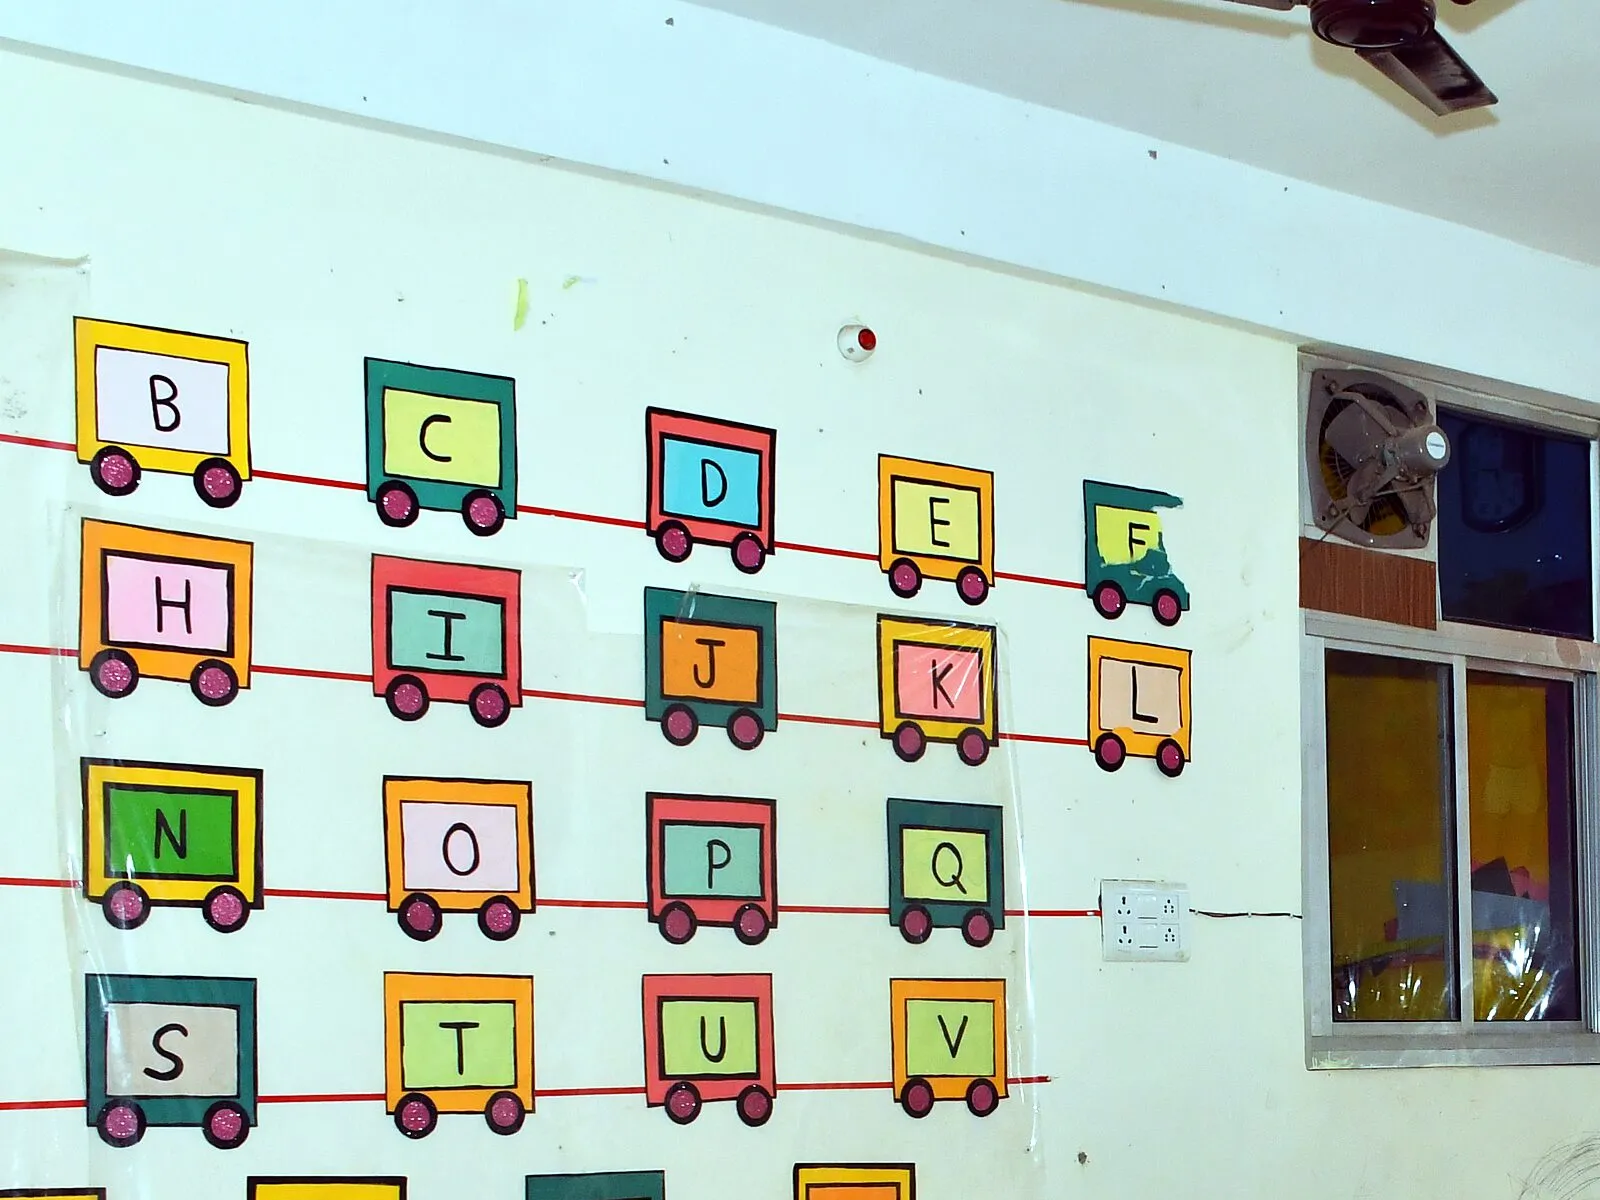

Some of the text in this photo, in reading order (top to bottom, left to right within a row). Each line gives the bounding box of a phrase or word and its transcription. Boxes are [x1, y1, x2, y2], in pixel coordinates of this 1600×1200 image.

[150, 375, 1150, 558] B C D E F
[155, 577, 1158, 724] H I J K L
[154, 809, 967, 894] N O P Q
[143, 1015, 968, 1081] S T U V
